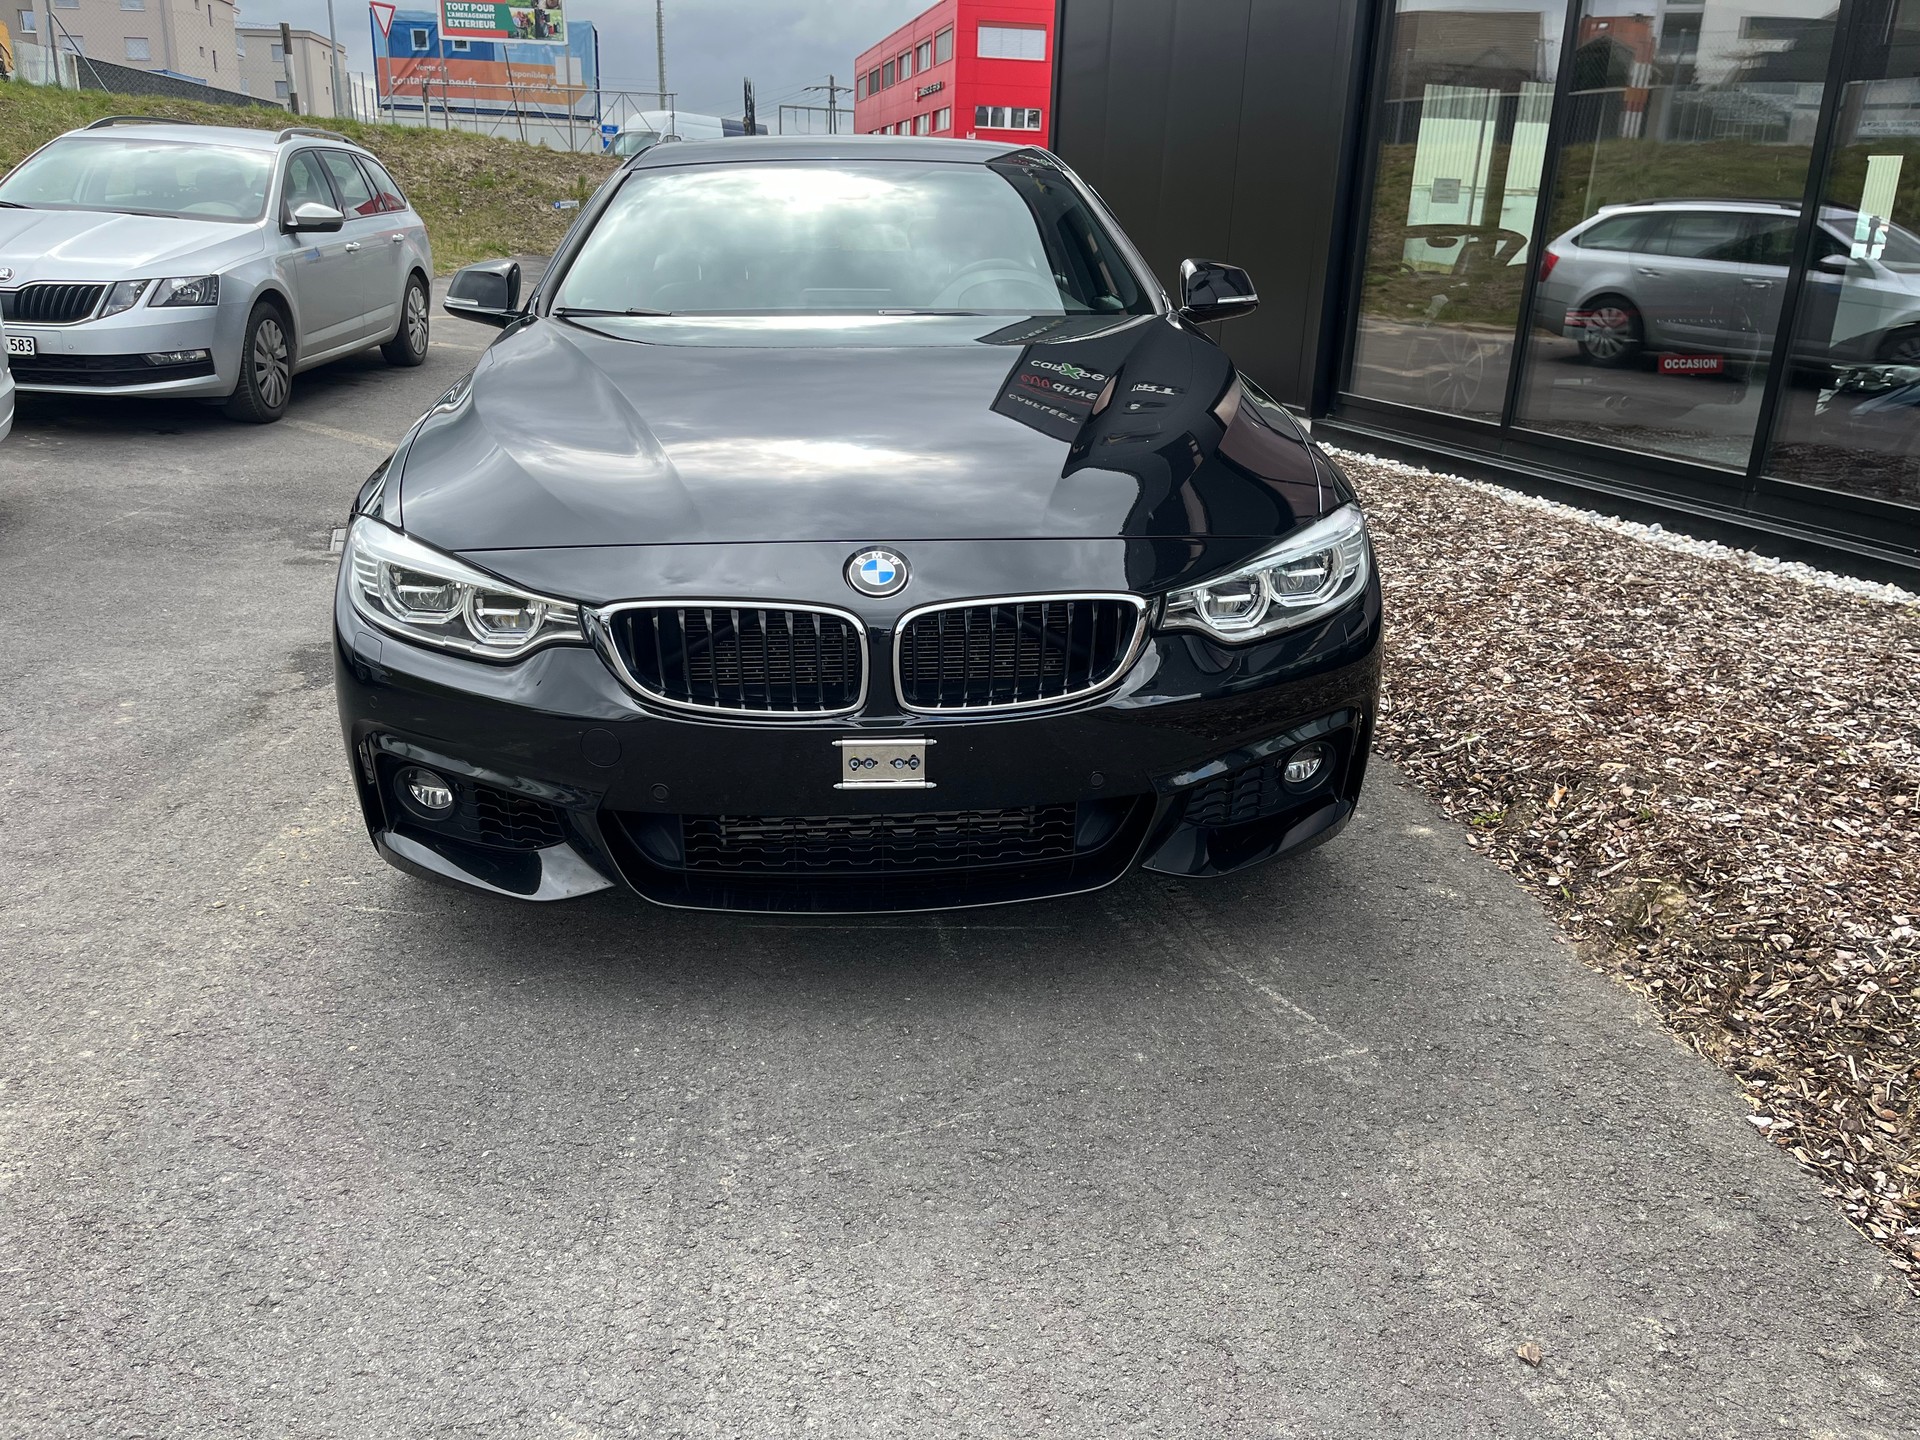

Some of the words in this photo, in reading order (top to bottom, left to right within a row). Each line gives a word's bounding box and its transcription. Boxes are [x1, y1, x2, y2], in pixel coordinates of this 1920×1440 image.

[446, 2, 469, 11] TOUT
[471, 4, 495, 13] POUR
[448, 19, 496, 29] EXTERIEUR
[1664, 358, 1718, 369] OCCASION
[854, 551, 902, 566] BMW
